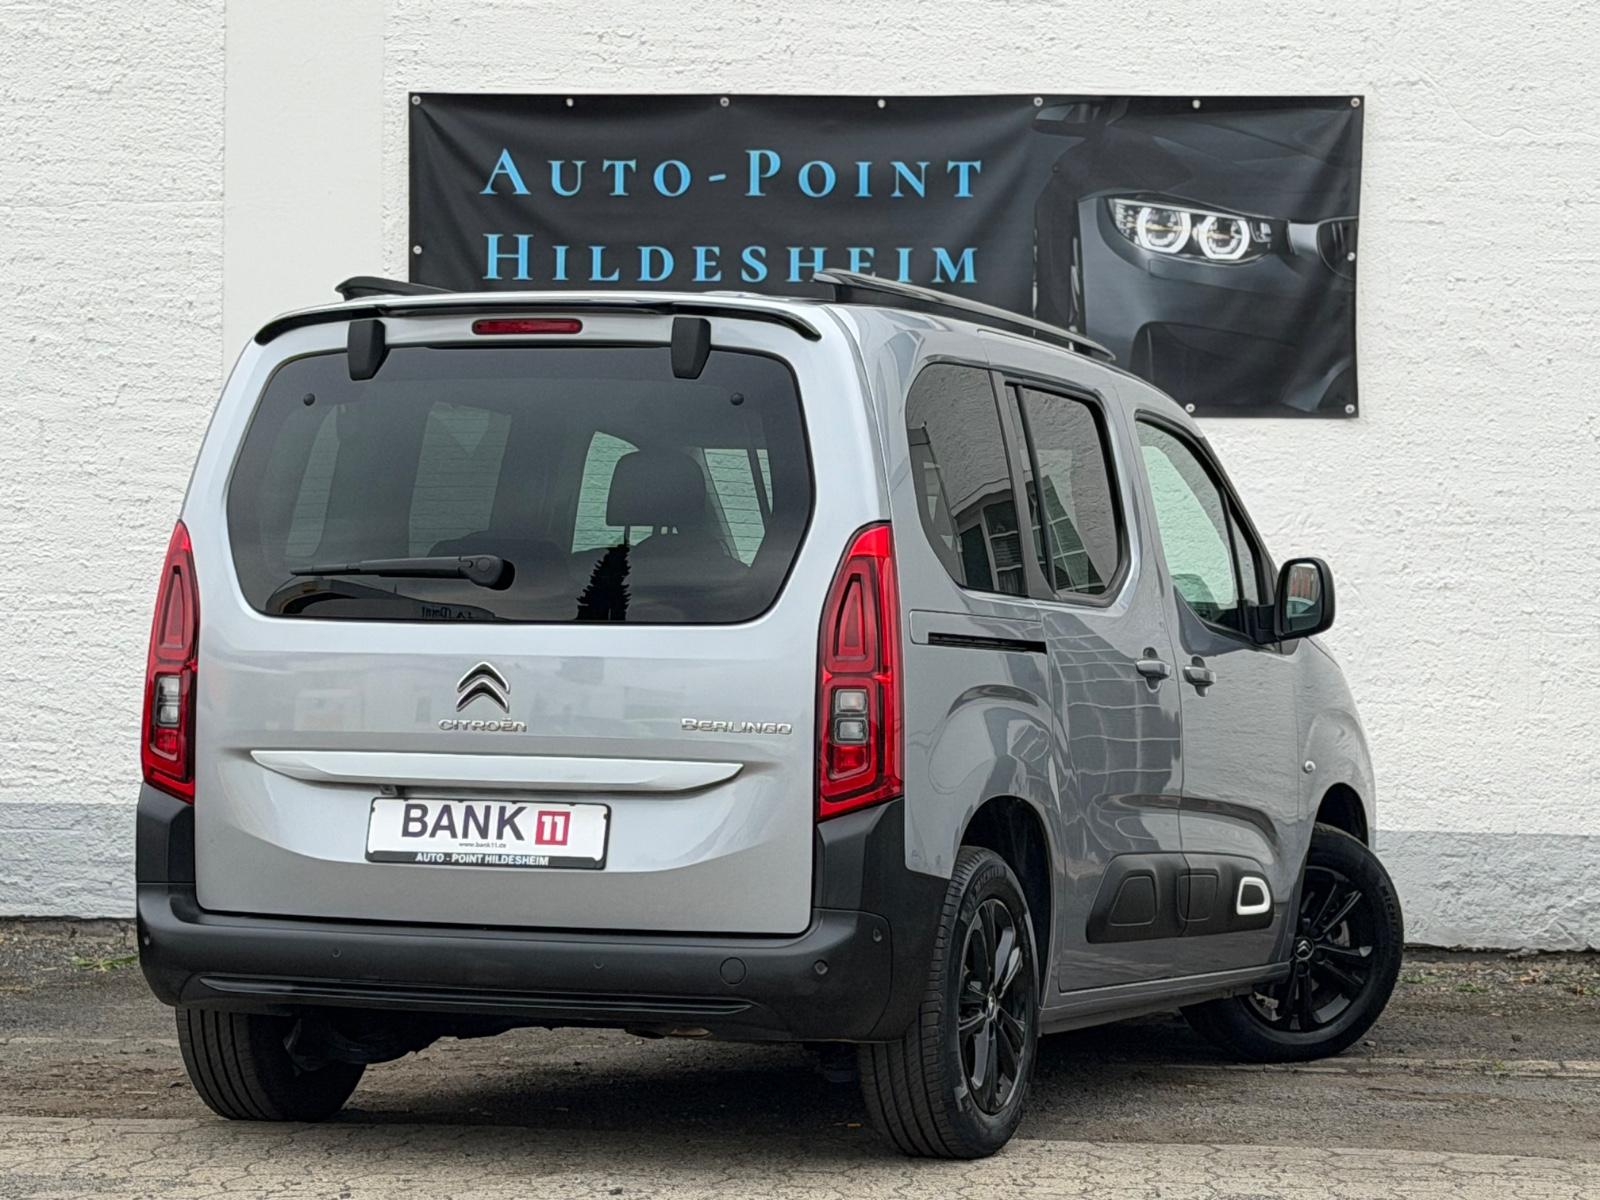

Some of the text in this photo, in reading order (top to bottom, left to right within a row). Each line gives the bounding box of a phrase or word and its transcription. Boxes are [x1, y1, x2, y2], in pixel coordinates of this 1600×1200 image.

[482, 233, 979, 284] HILDESHEIM
[438, 717, 528, 733] CITROËN
[680, 718, 793, 736] BERLINGO
[401, 803, 567, 842] BANK 11
[415, 852, 445, 862] AUTO
[451, 853, 483, 864] POINT
[484, 854, 550, 866] HILDESHEIM
